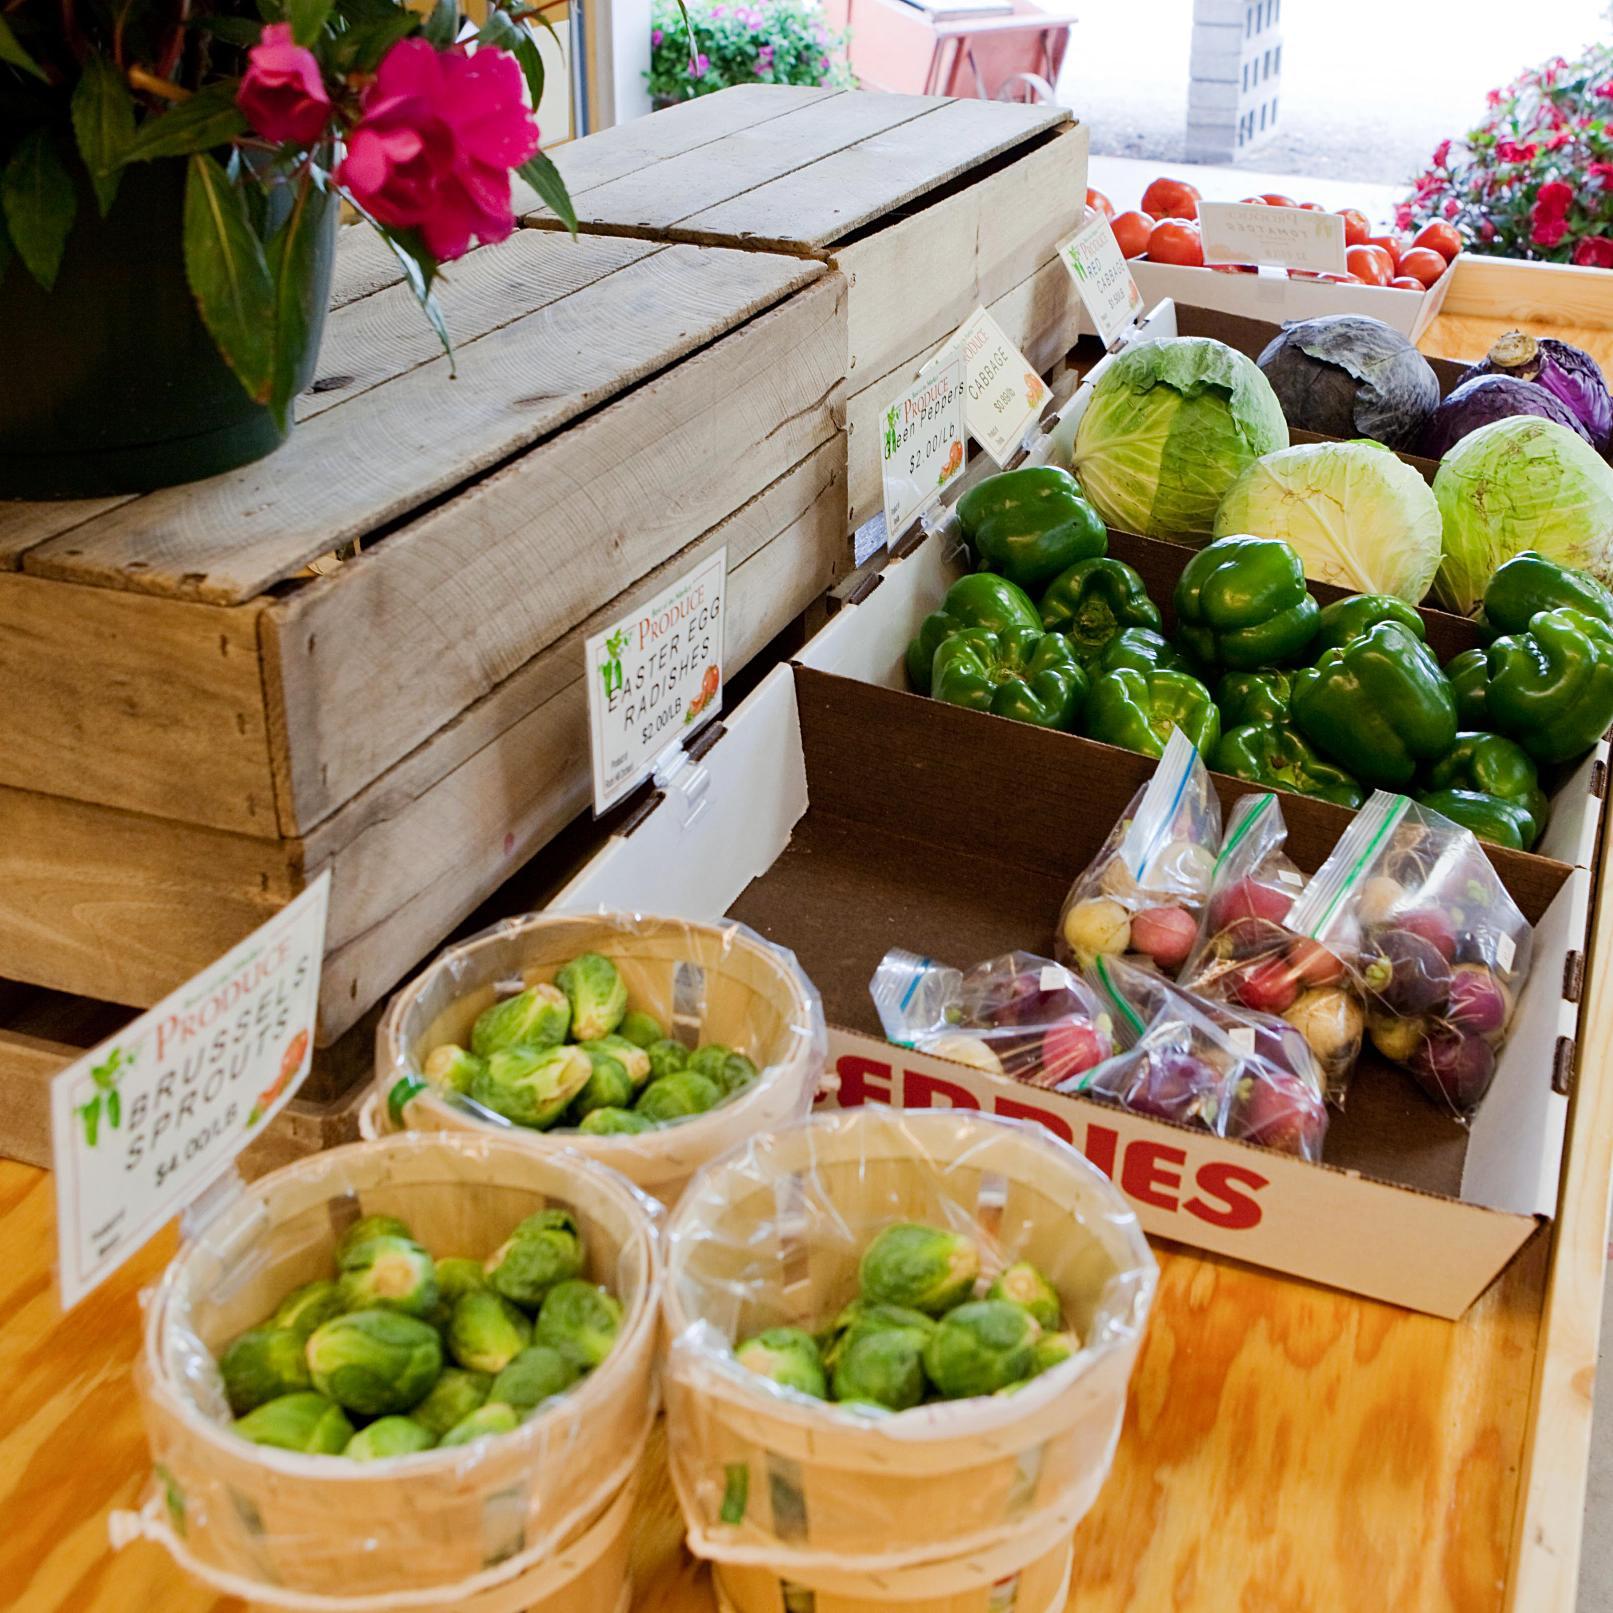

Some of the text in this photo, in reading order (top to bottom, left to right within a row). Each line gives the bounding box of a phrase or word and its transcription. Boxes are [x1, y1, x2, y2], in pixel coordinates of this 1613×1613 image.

[1087, 257, 1102, 280] RED
[904, 376, 949, 424] PRODUCE
[920, 381, 964, 429] Peppers
[967, 346, 1009, 401] CABBAGE
[909, 421, 955, 474] $2.00/Lb
[638, 584, 705, 652] PRODUCE
[607, 634, 680, 713] EASTER
[688, 596, 721, 643] EGG
[624, 636, 710, 732] RADISHES
[154, 936, 291, 1064] PRODUCE
[128, 954, 309, 1132] BRUSSELS
[124, 1007, 290, 1173] SPROUTS
